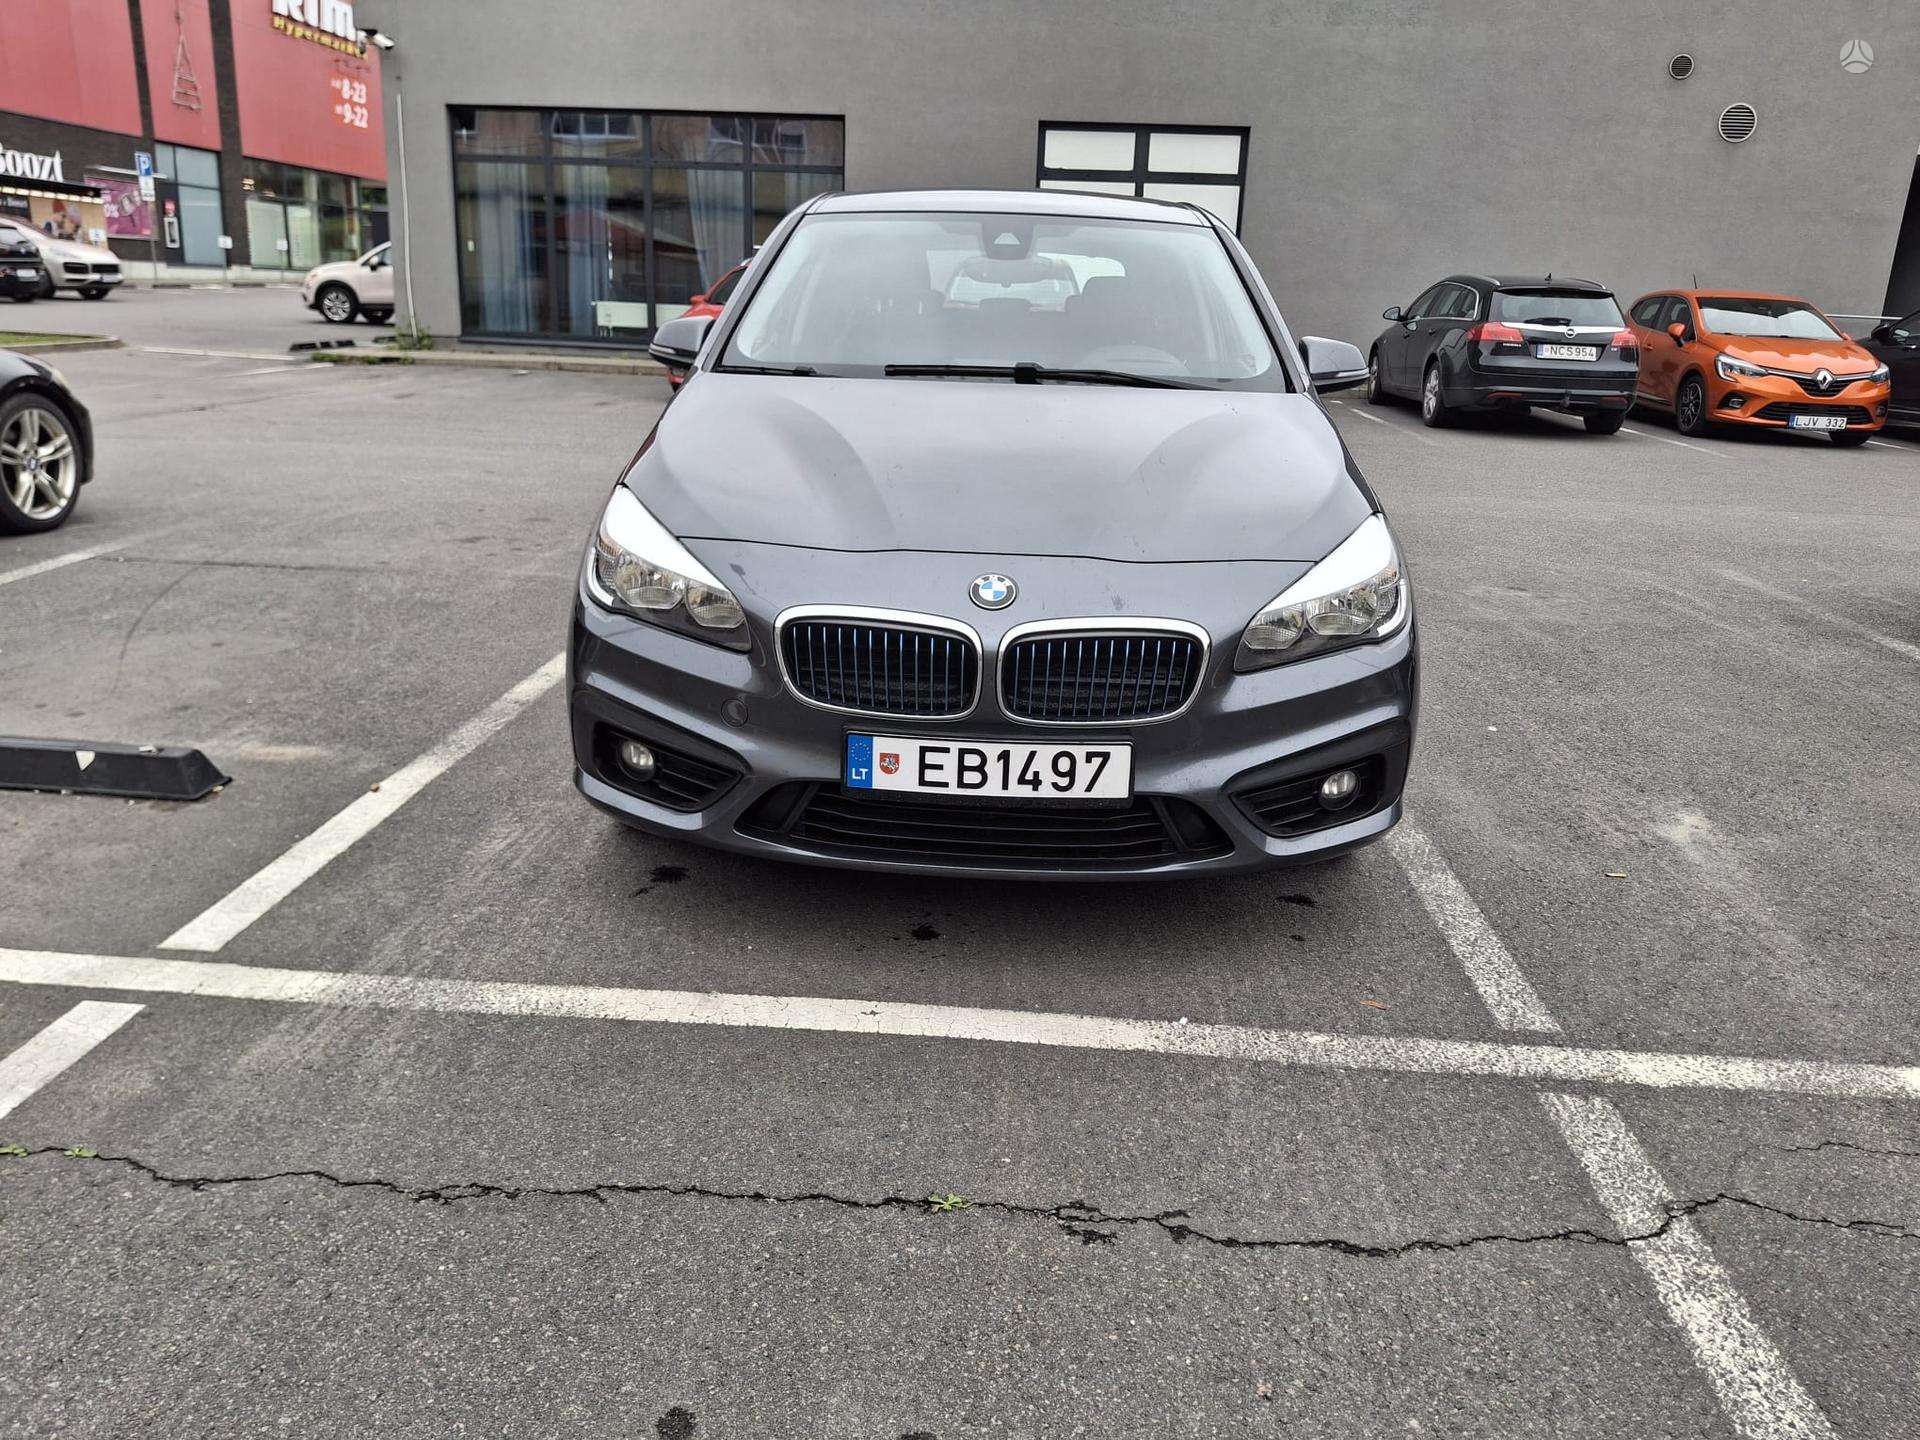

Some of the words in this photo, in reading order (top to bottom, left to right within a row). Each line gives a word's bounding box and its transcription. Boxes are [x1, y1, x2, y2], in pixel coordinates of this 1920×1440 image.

[1795, 417, 1818, 427] LJV
[1825, 418, 1845, 428] 332
[852, 767, 868, 780] LT
[918, 745, 1111, 793] EB1497
